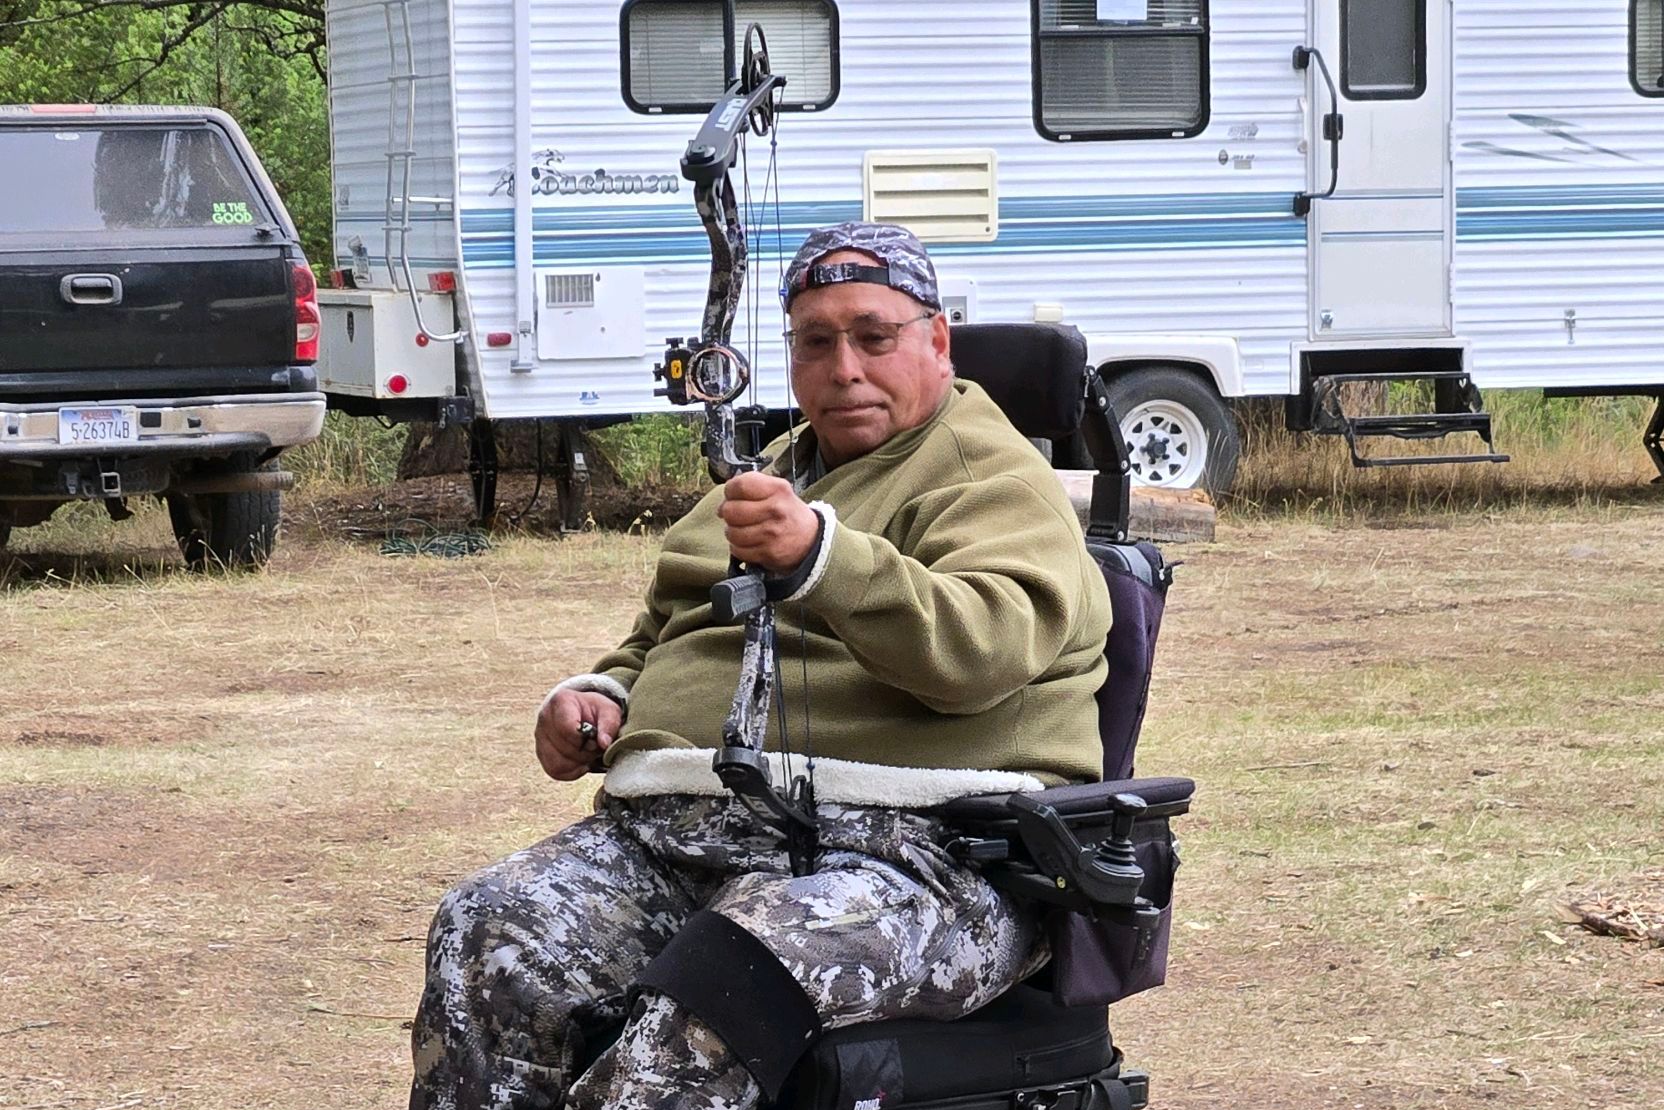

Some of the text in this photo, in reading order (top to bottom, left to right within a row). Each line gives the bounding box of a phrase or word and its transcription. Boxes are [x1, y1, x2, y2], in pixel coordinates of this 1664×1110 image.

[212, 202, 248, 213] BE THE
[212, 211, 253, 225] GOOD
